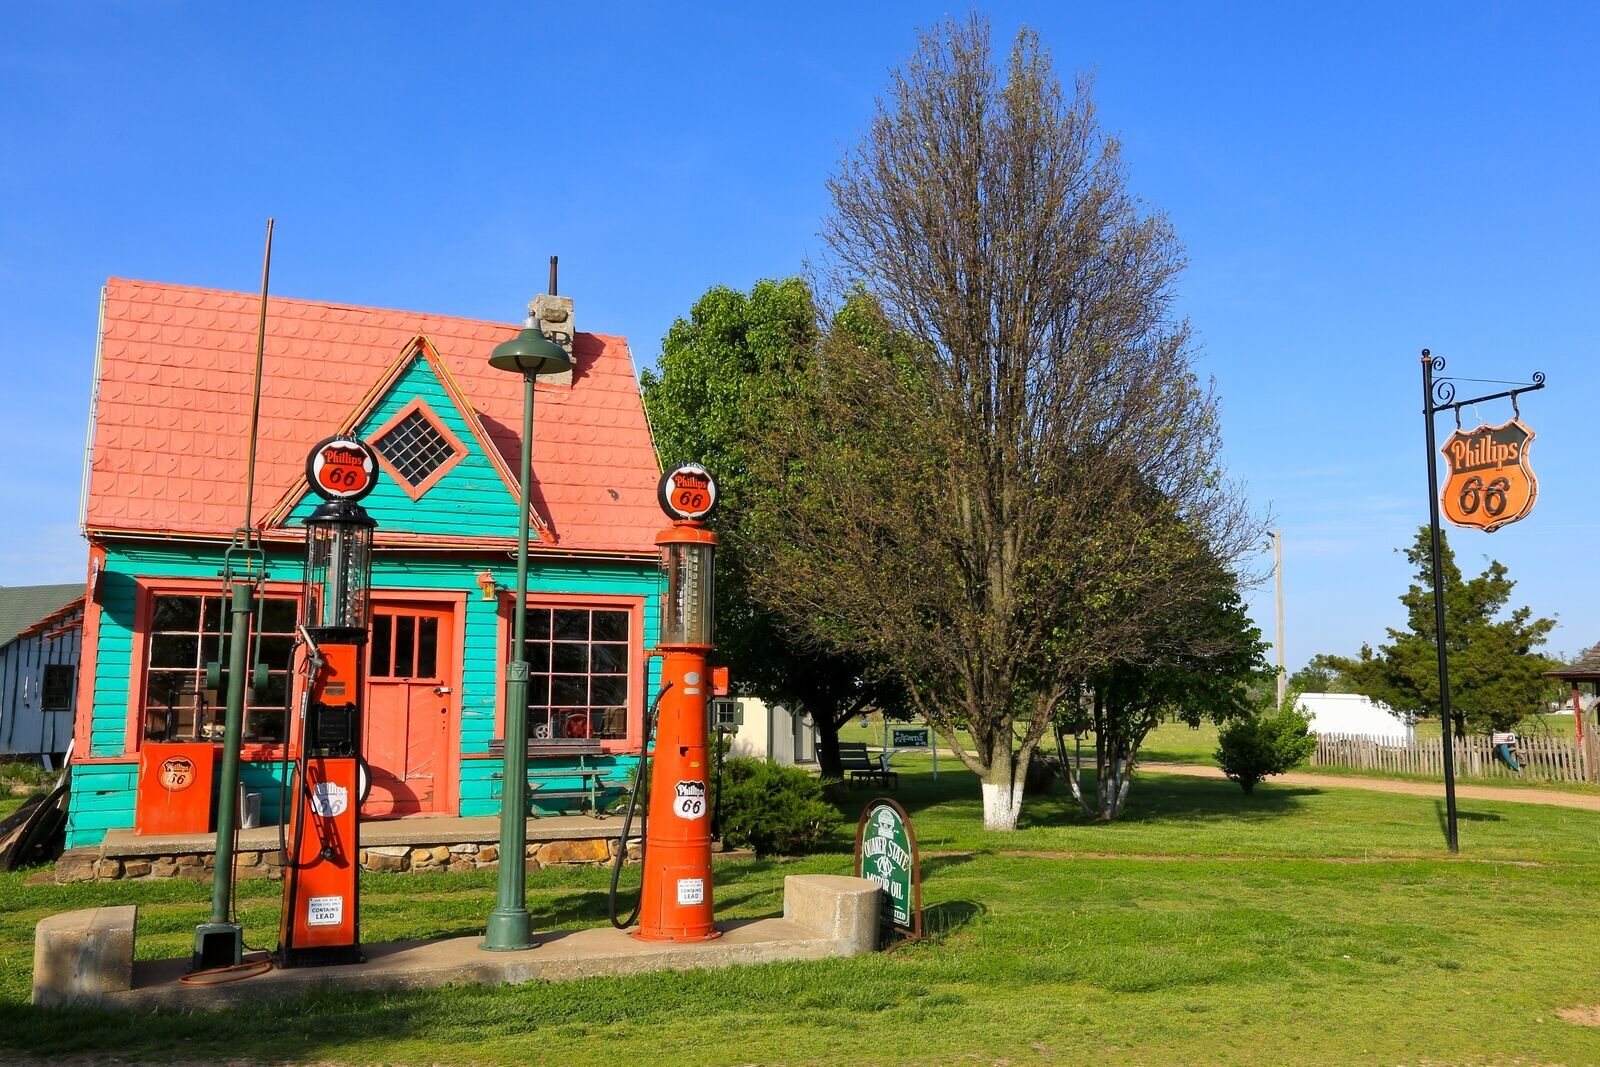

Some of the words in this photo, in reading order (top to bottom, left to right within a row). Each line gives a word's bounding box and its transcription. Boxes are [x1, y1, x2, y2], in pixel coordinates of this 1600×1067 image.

[325, 450, 362, 466] Phillips
[1451, 435, 1518, 471] Phillips
[330, 468, 357, 486] 66
[675, 475, 707, 491] Phillips
[680, 491, 703, 508] 66
[1459, 476, 1510, 517] 66
[677, 784, 704, 799] Phillips
[317, 800, 342, 814] 66
[682, 799, 701, 814] 66
[865, 836, 887, 858] QUAKER
[888, 840, 909, 871] STATE
[890, 881, 904, 900] OIL
